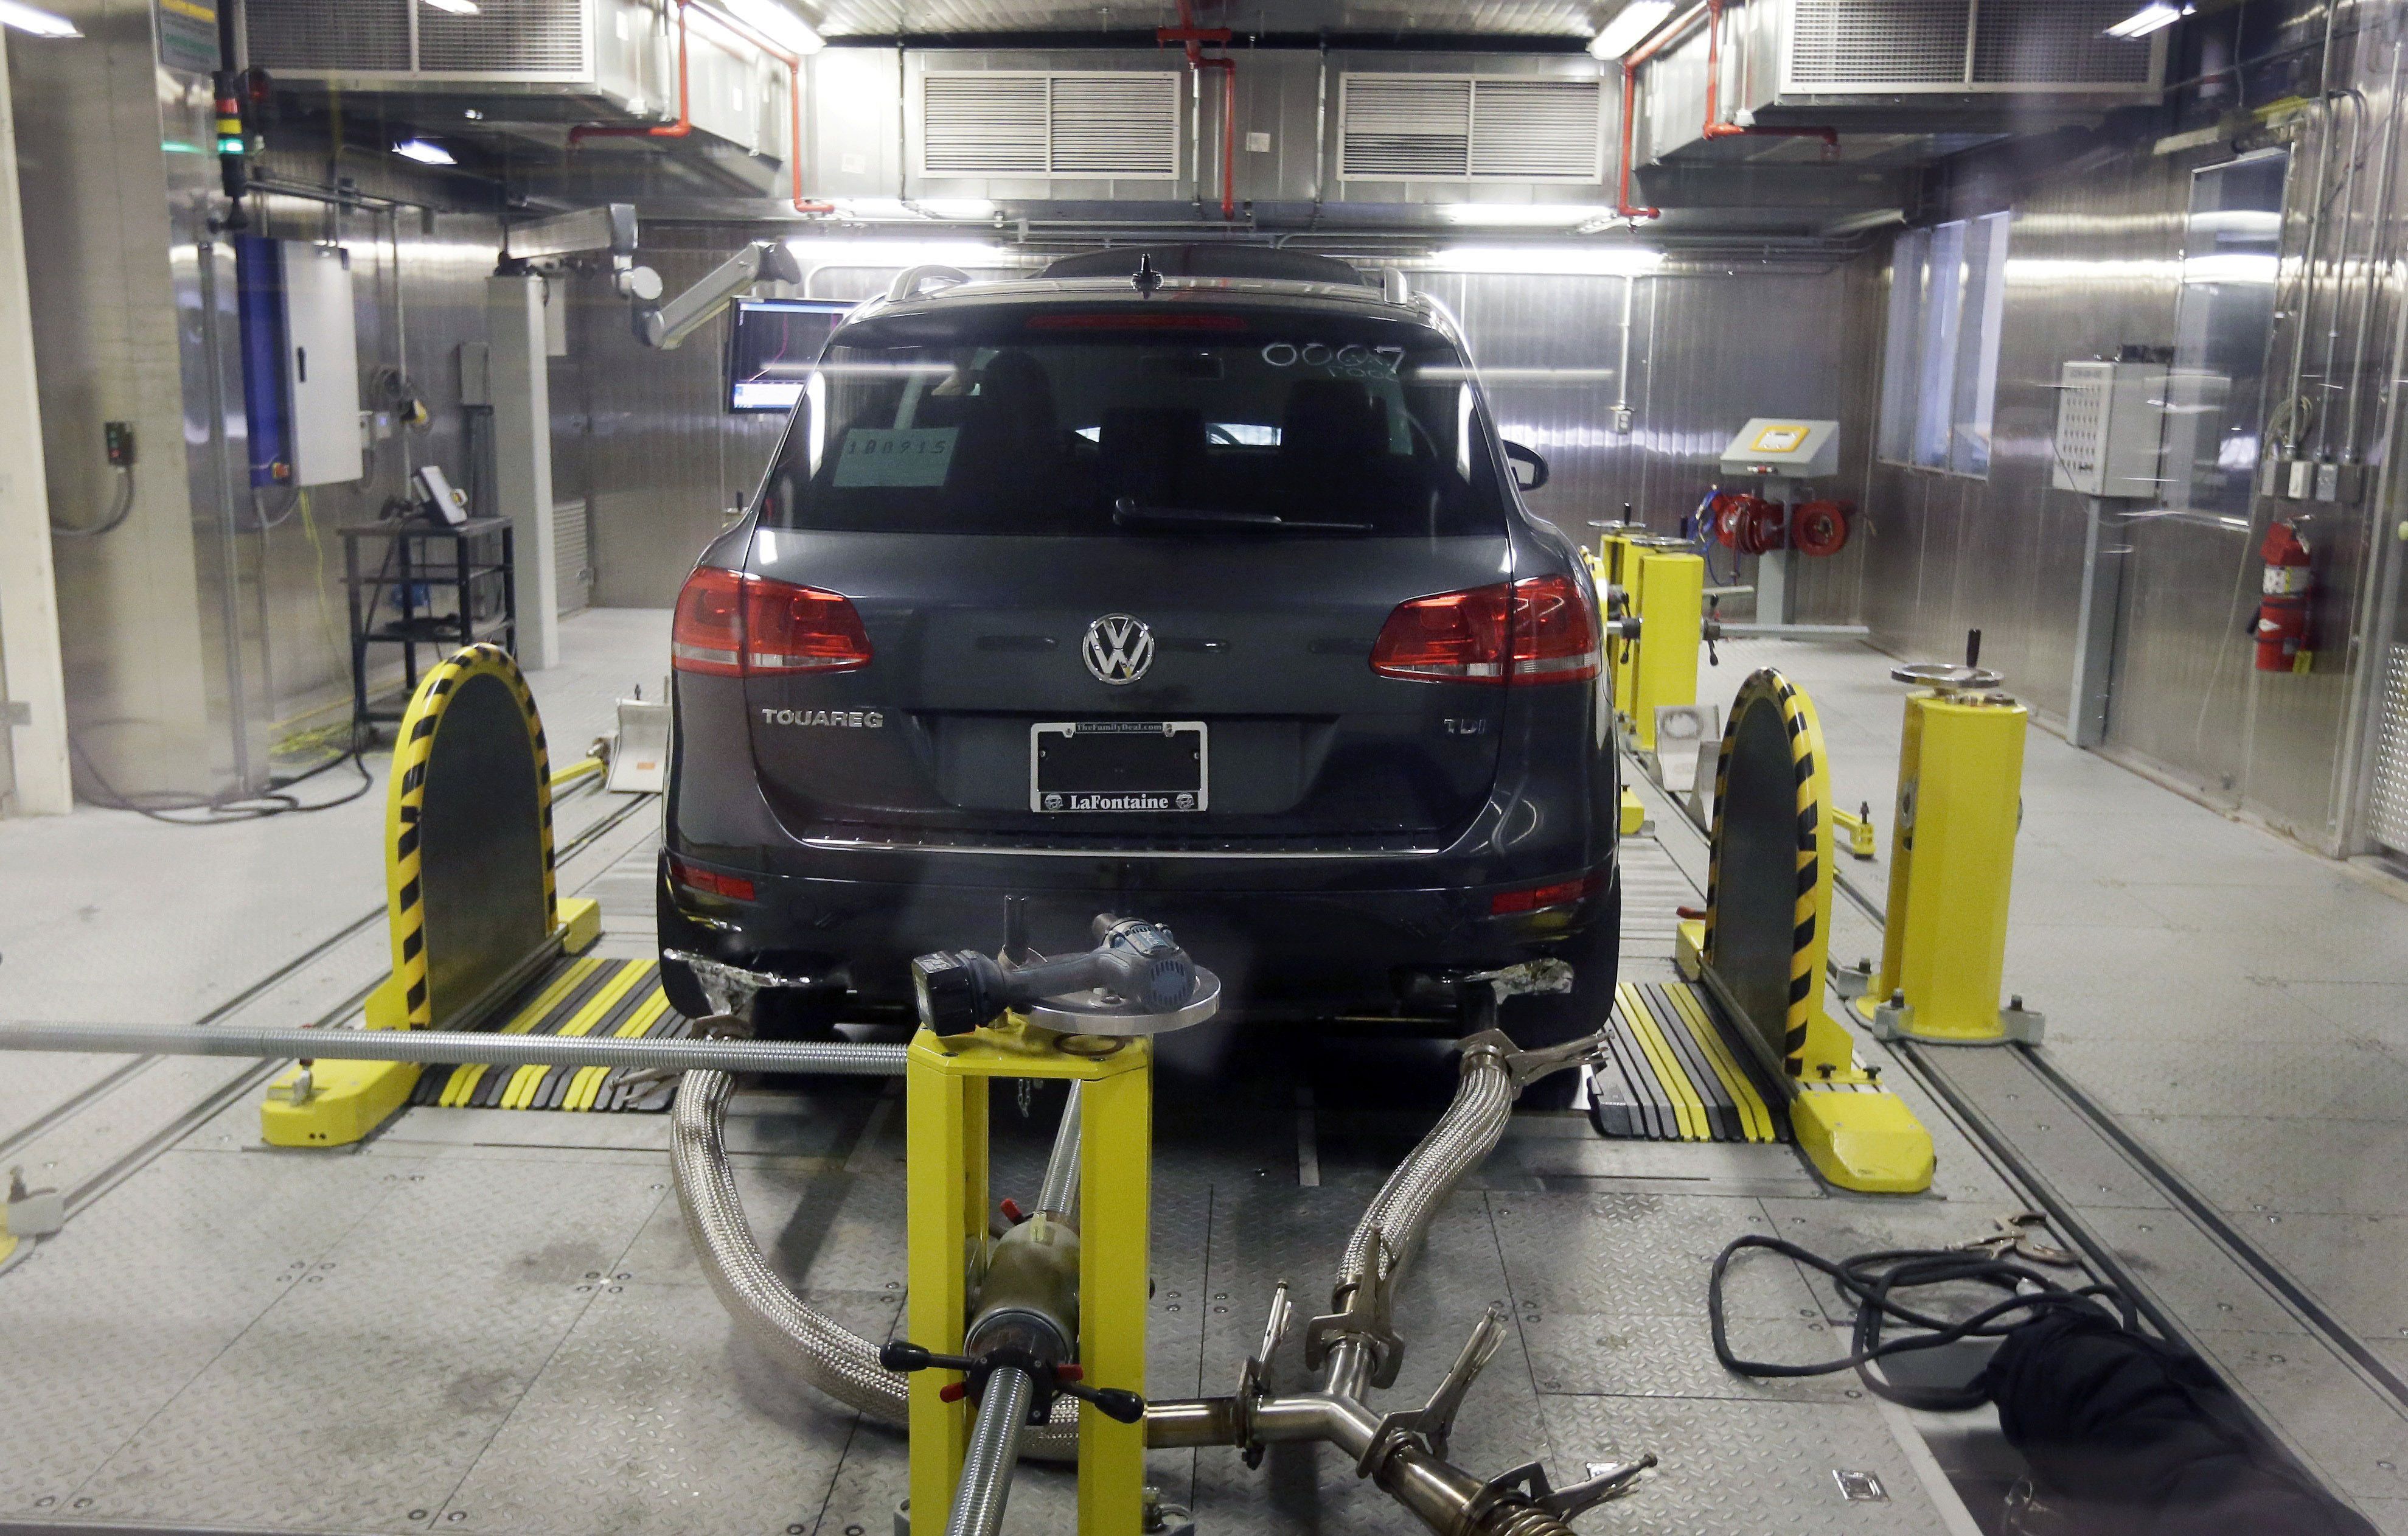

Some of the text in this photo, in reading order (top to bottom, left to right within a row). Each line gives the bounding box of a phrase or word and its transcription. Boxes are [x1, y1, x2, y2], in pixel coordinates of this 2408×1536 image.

[762, 708, 883, 728] TOUAREG
[1077, 724, 1163, 733] TheFamilyDeal.com
[1444, 719, 1486, 734] TDI
[1070, 794, 1169, 809] LaFontaine
